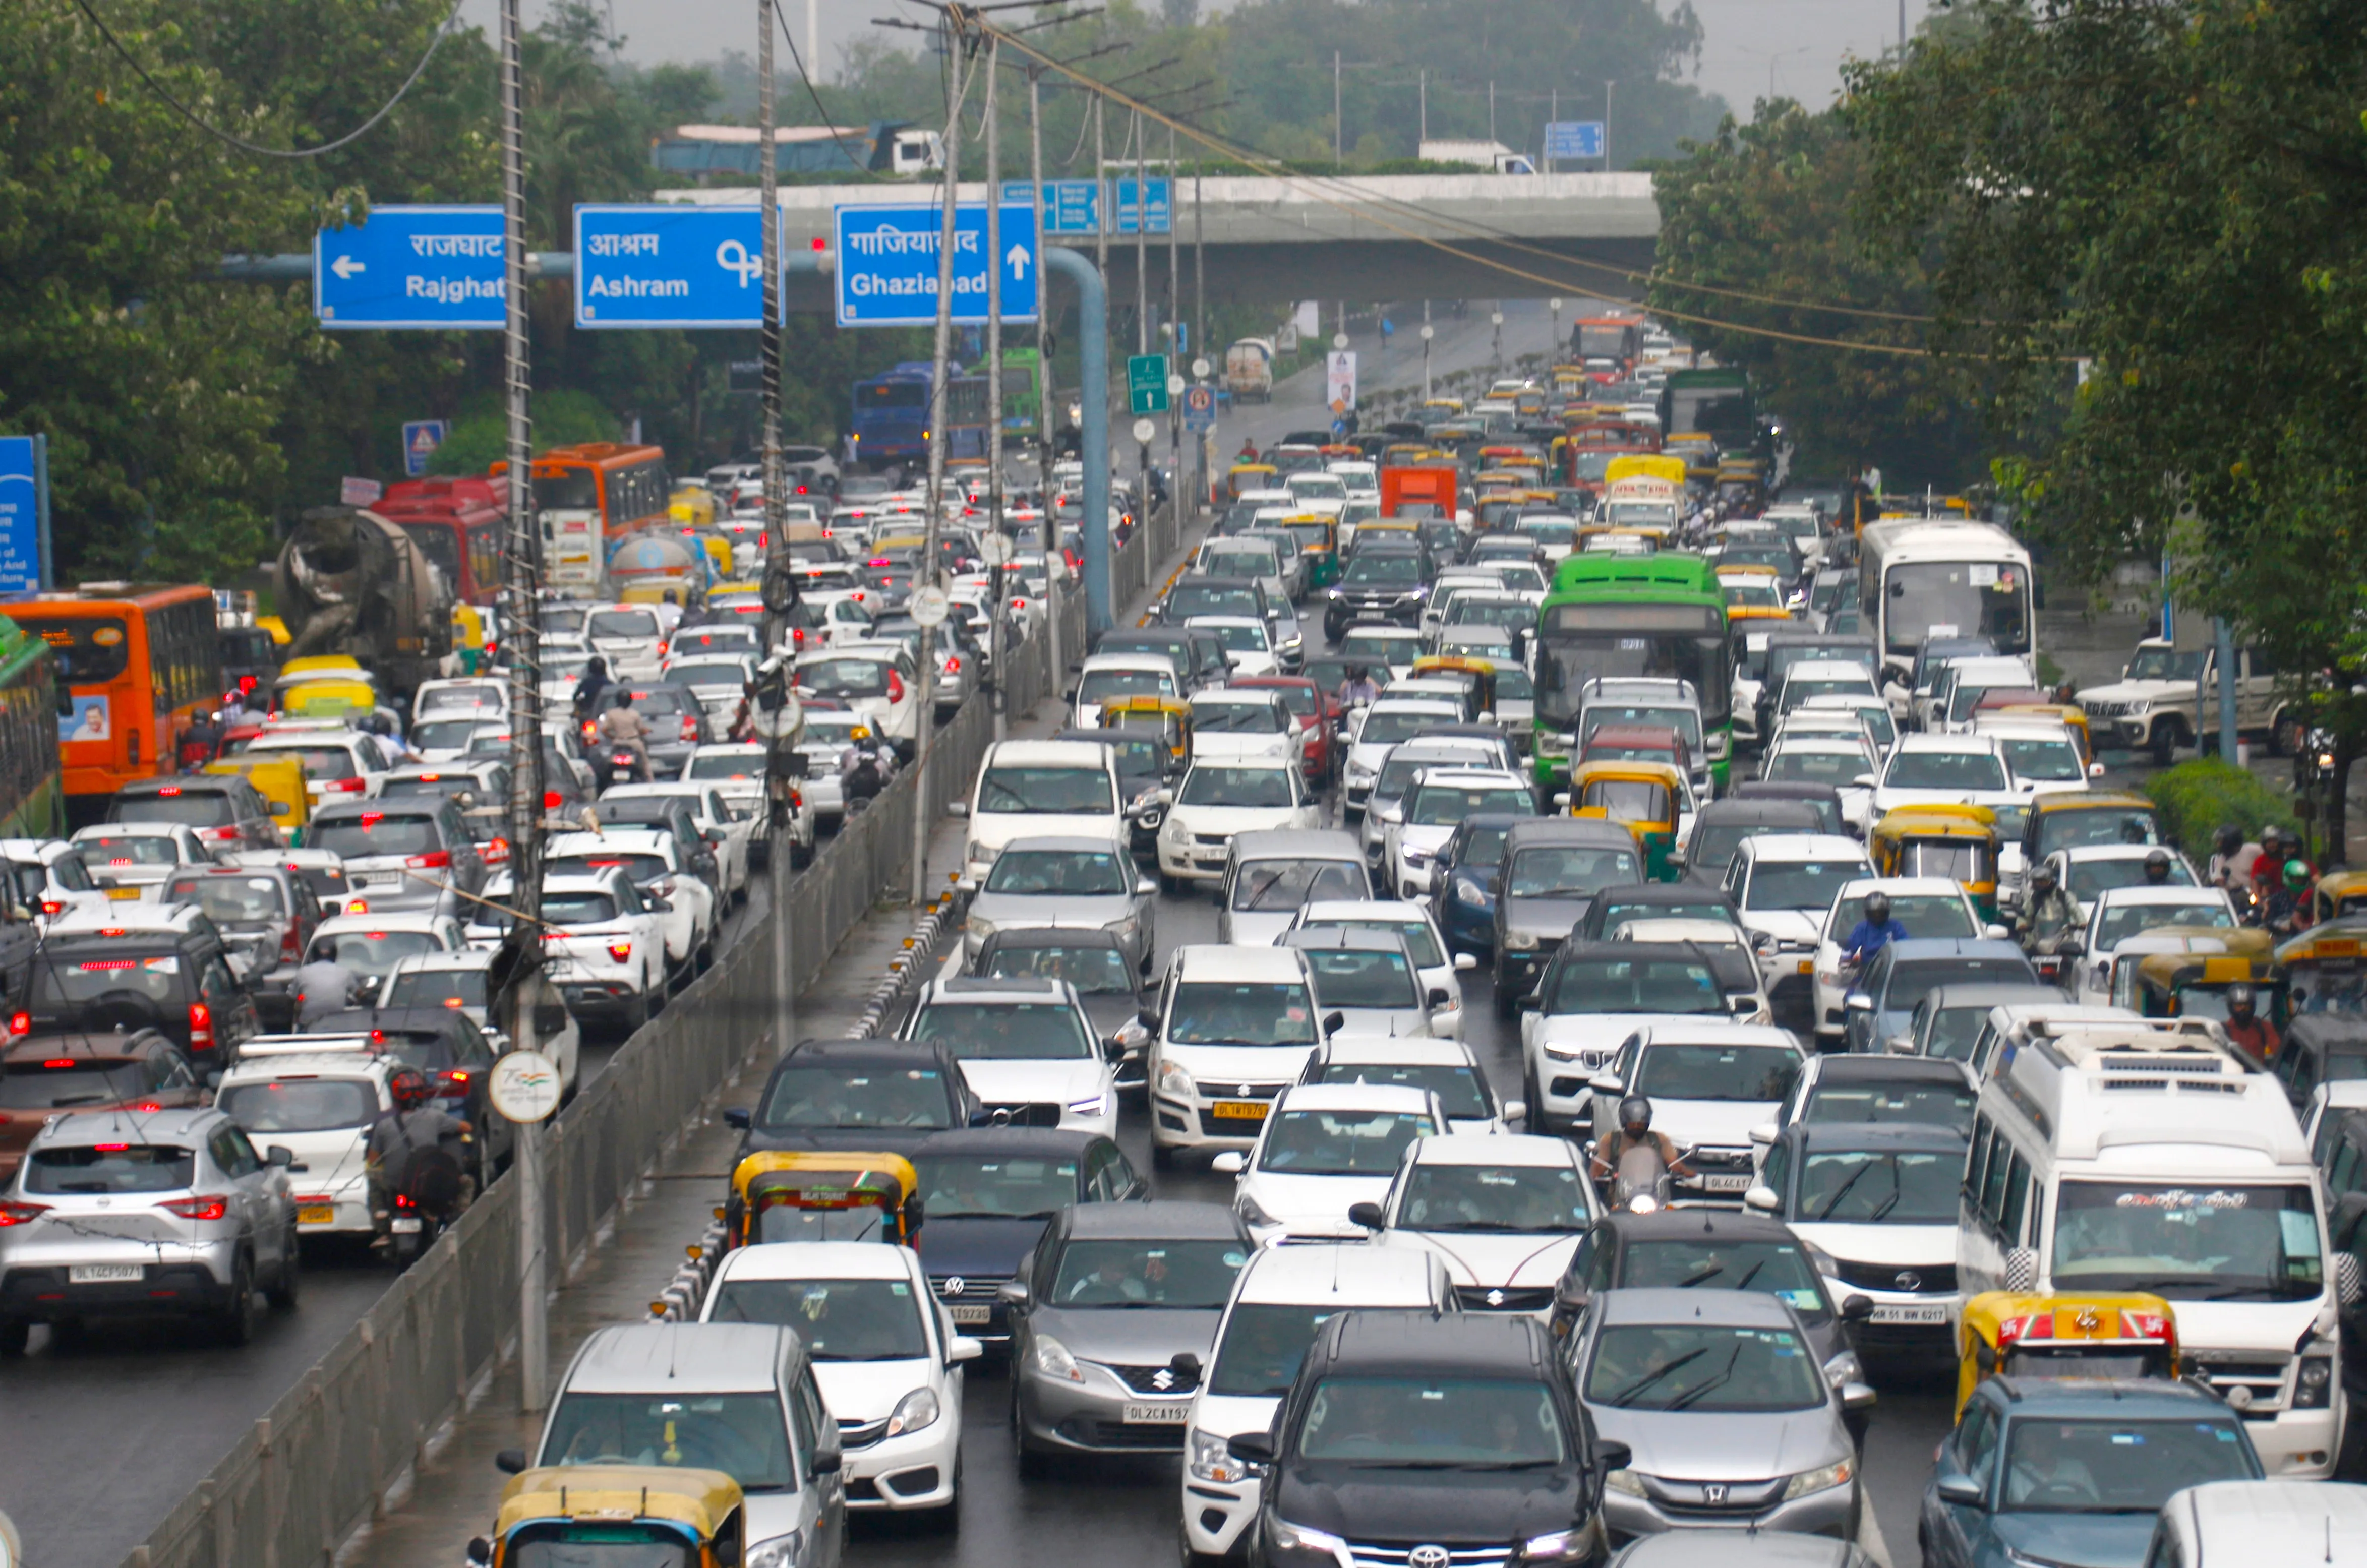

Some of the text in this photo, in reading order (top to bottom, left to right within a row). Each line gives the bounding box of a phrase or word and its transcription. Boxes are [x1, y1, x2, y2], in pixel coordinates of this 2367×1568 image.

[409, 234, 503, 257] राजघाट
[588, 233, 659, 256] आश्रम
[406, 275, 505, 304] Rajghat
[588, 274, 688, 297] Ashram
